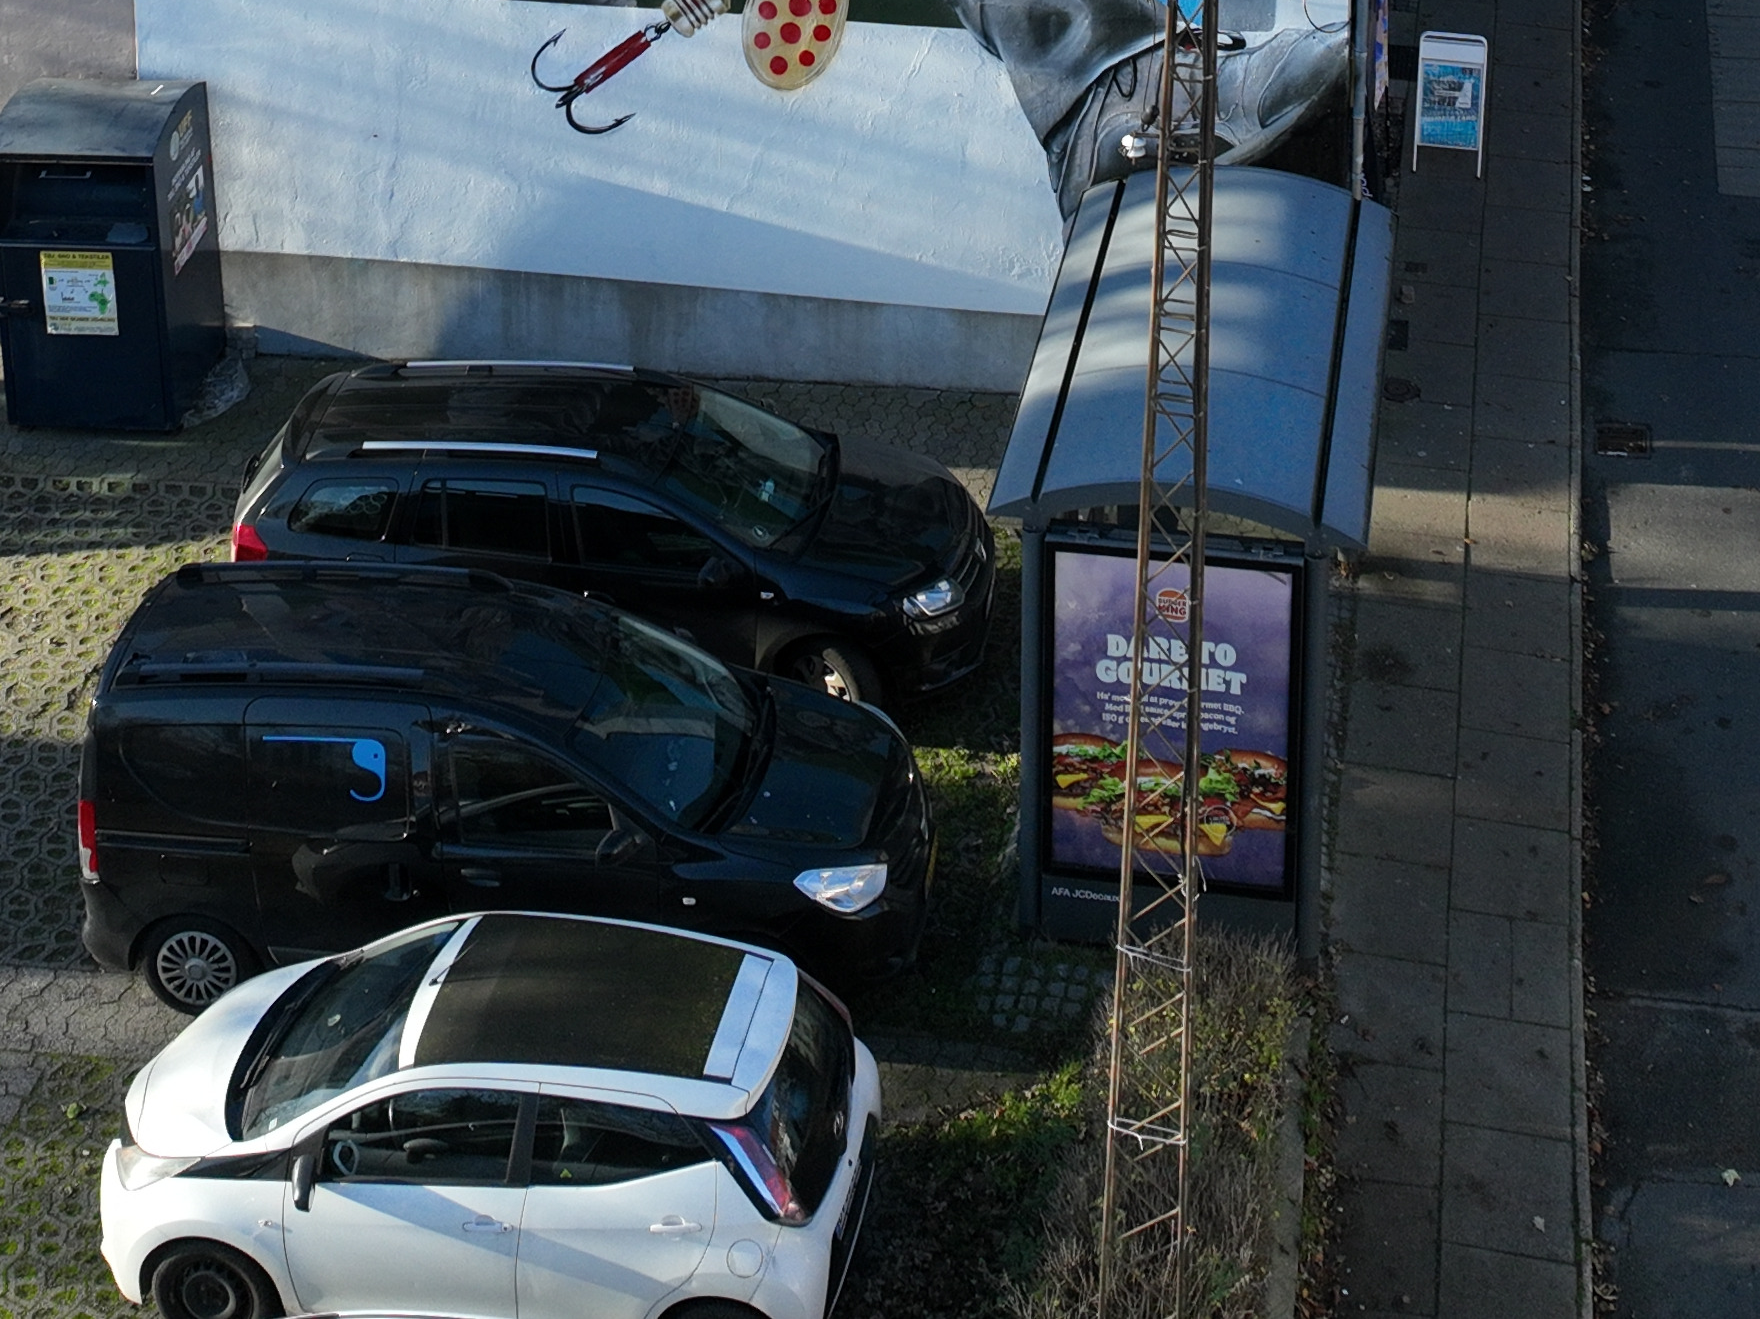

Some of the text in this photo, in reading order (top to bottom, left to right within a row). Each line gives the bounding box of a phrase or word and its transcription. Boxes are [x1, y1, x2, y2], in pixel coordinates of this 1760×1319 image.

[1157, 604, 1188, 617] KING
[1201, 641, 1237, 667] TO
[1104, 703, 1124, 713] Med
[1051, 886, 1072, 898] AFA
